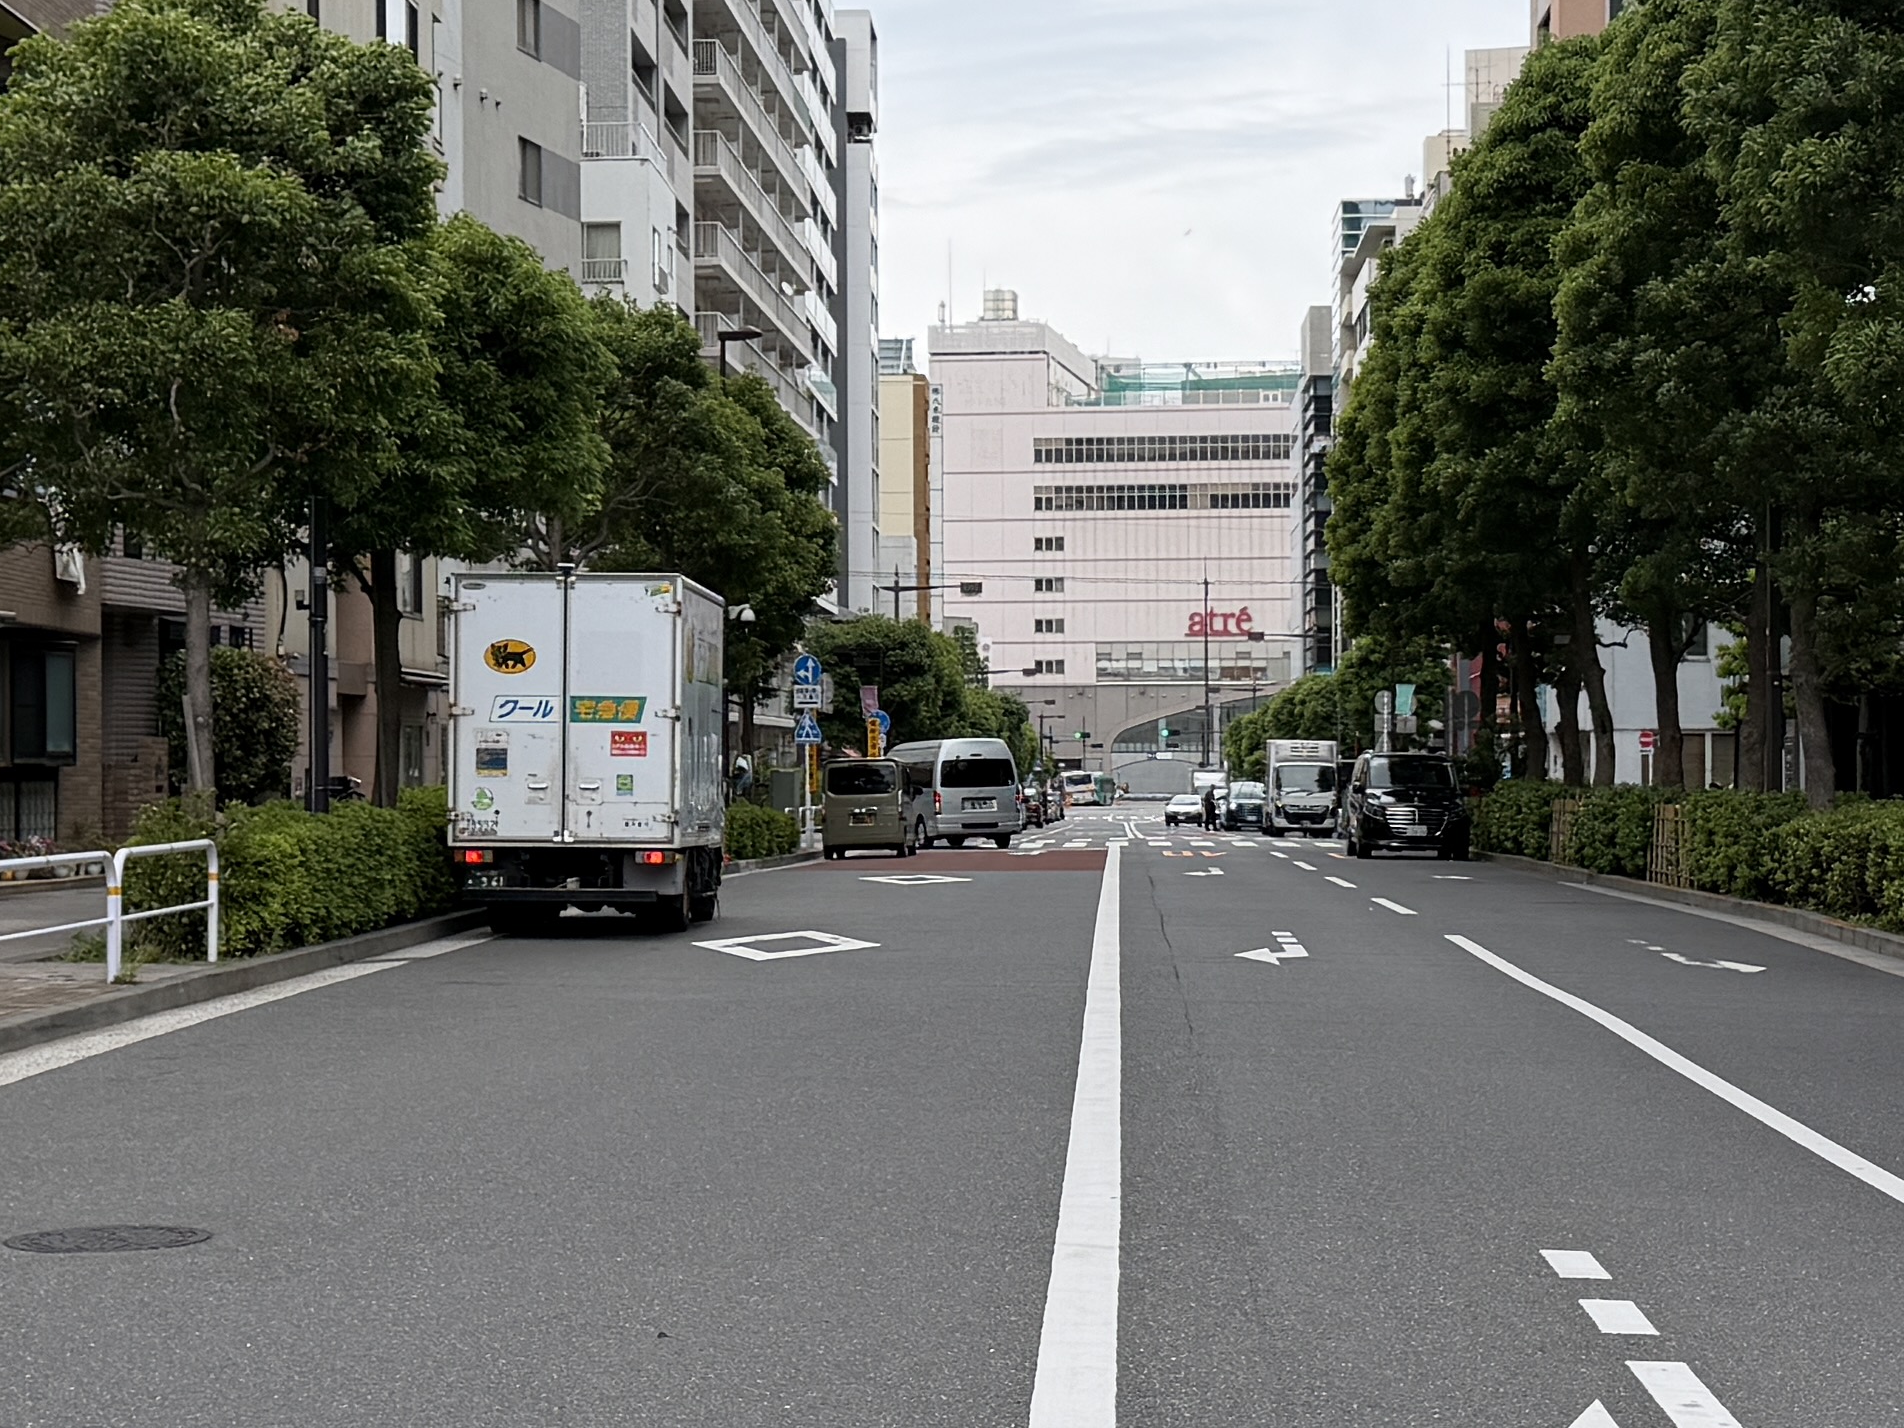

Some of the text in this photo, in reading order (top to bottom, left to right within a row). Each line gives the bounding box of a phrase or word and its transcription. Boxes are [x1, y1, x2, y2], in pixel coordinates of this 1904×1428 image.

[1187, 606, 1253, 634] atré
[497, 699, 554, 719] クール
